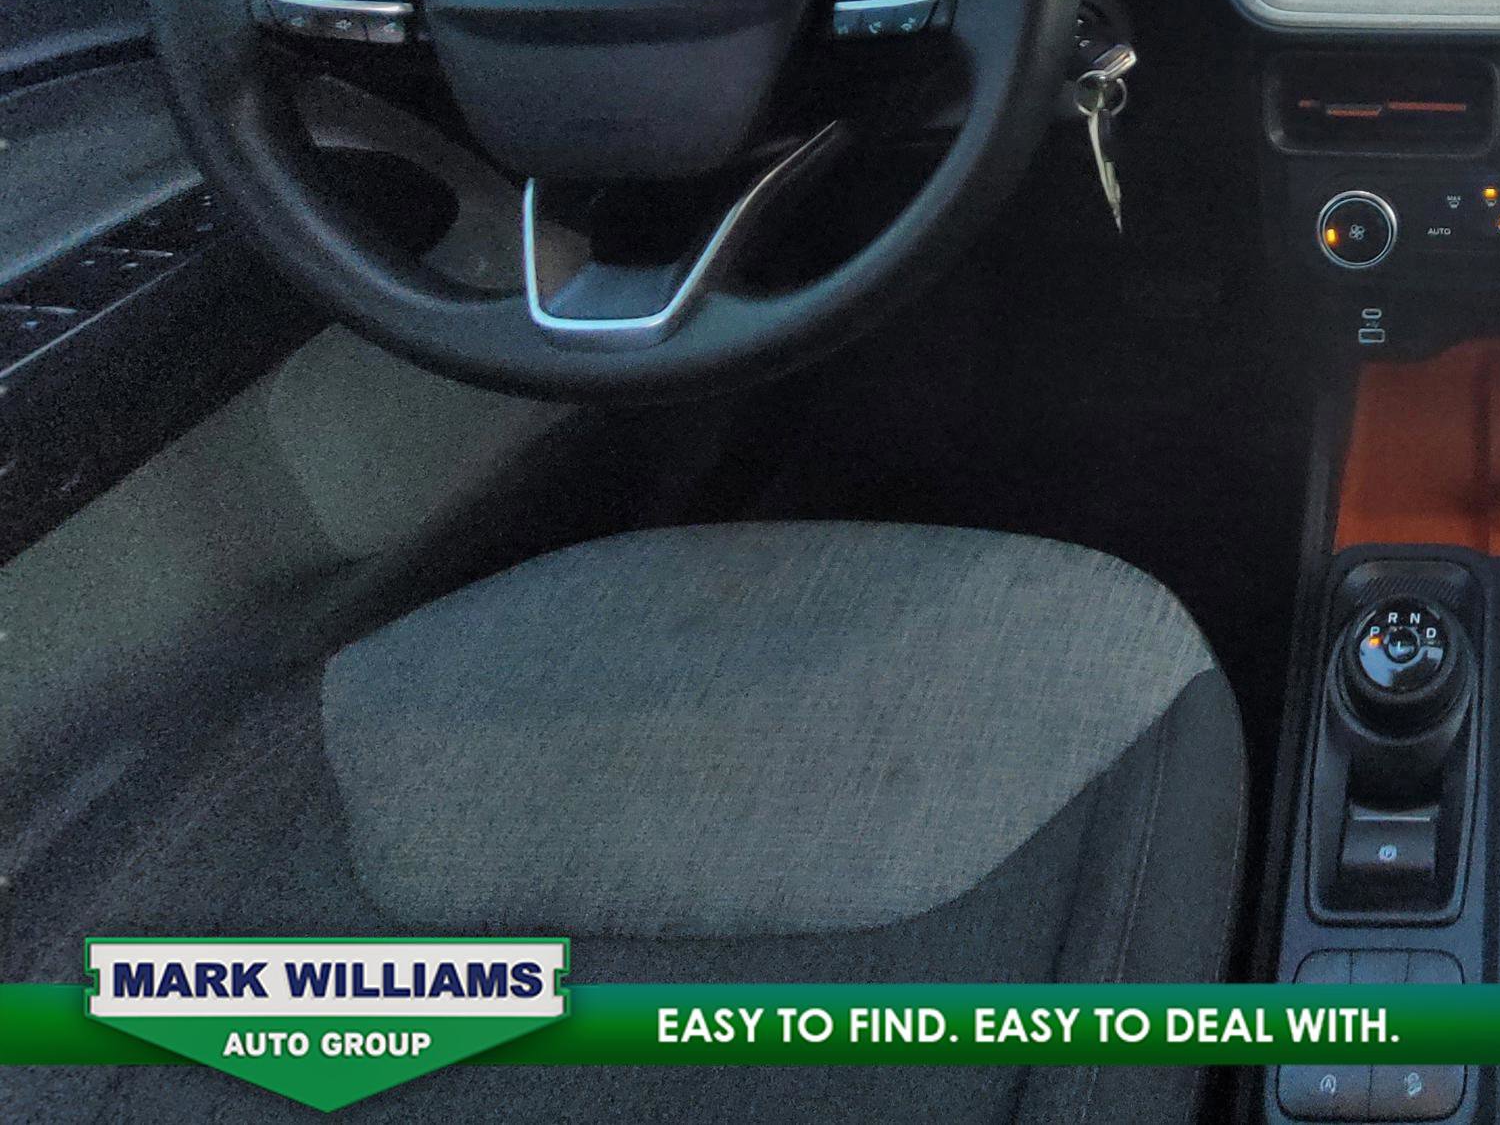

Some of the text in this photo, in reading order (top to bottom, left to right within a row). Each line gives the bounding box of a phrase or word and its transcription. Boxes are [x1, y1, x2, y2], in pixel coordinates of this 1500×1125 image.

[1427, 227, 1451, 236] AUTO
[1388, 612, 1420, 624] R N
[1370, 626, 1437, 639] P D
